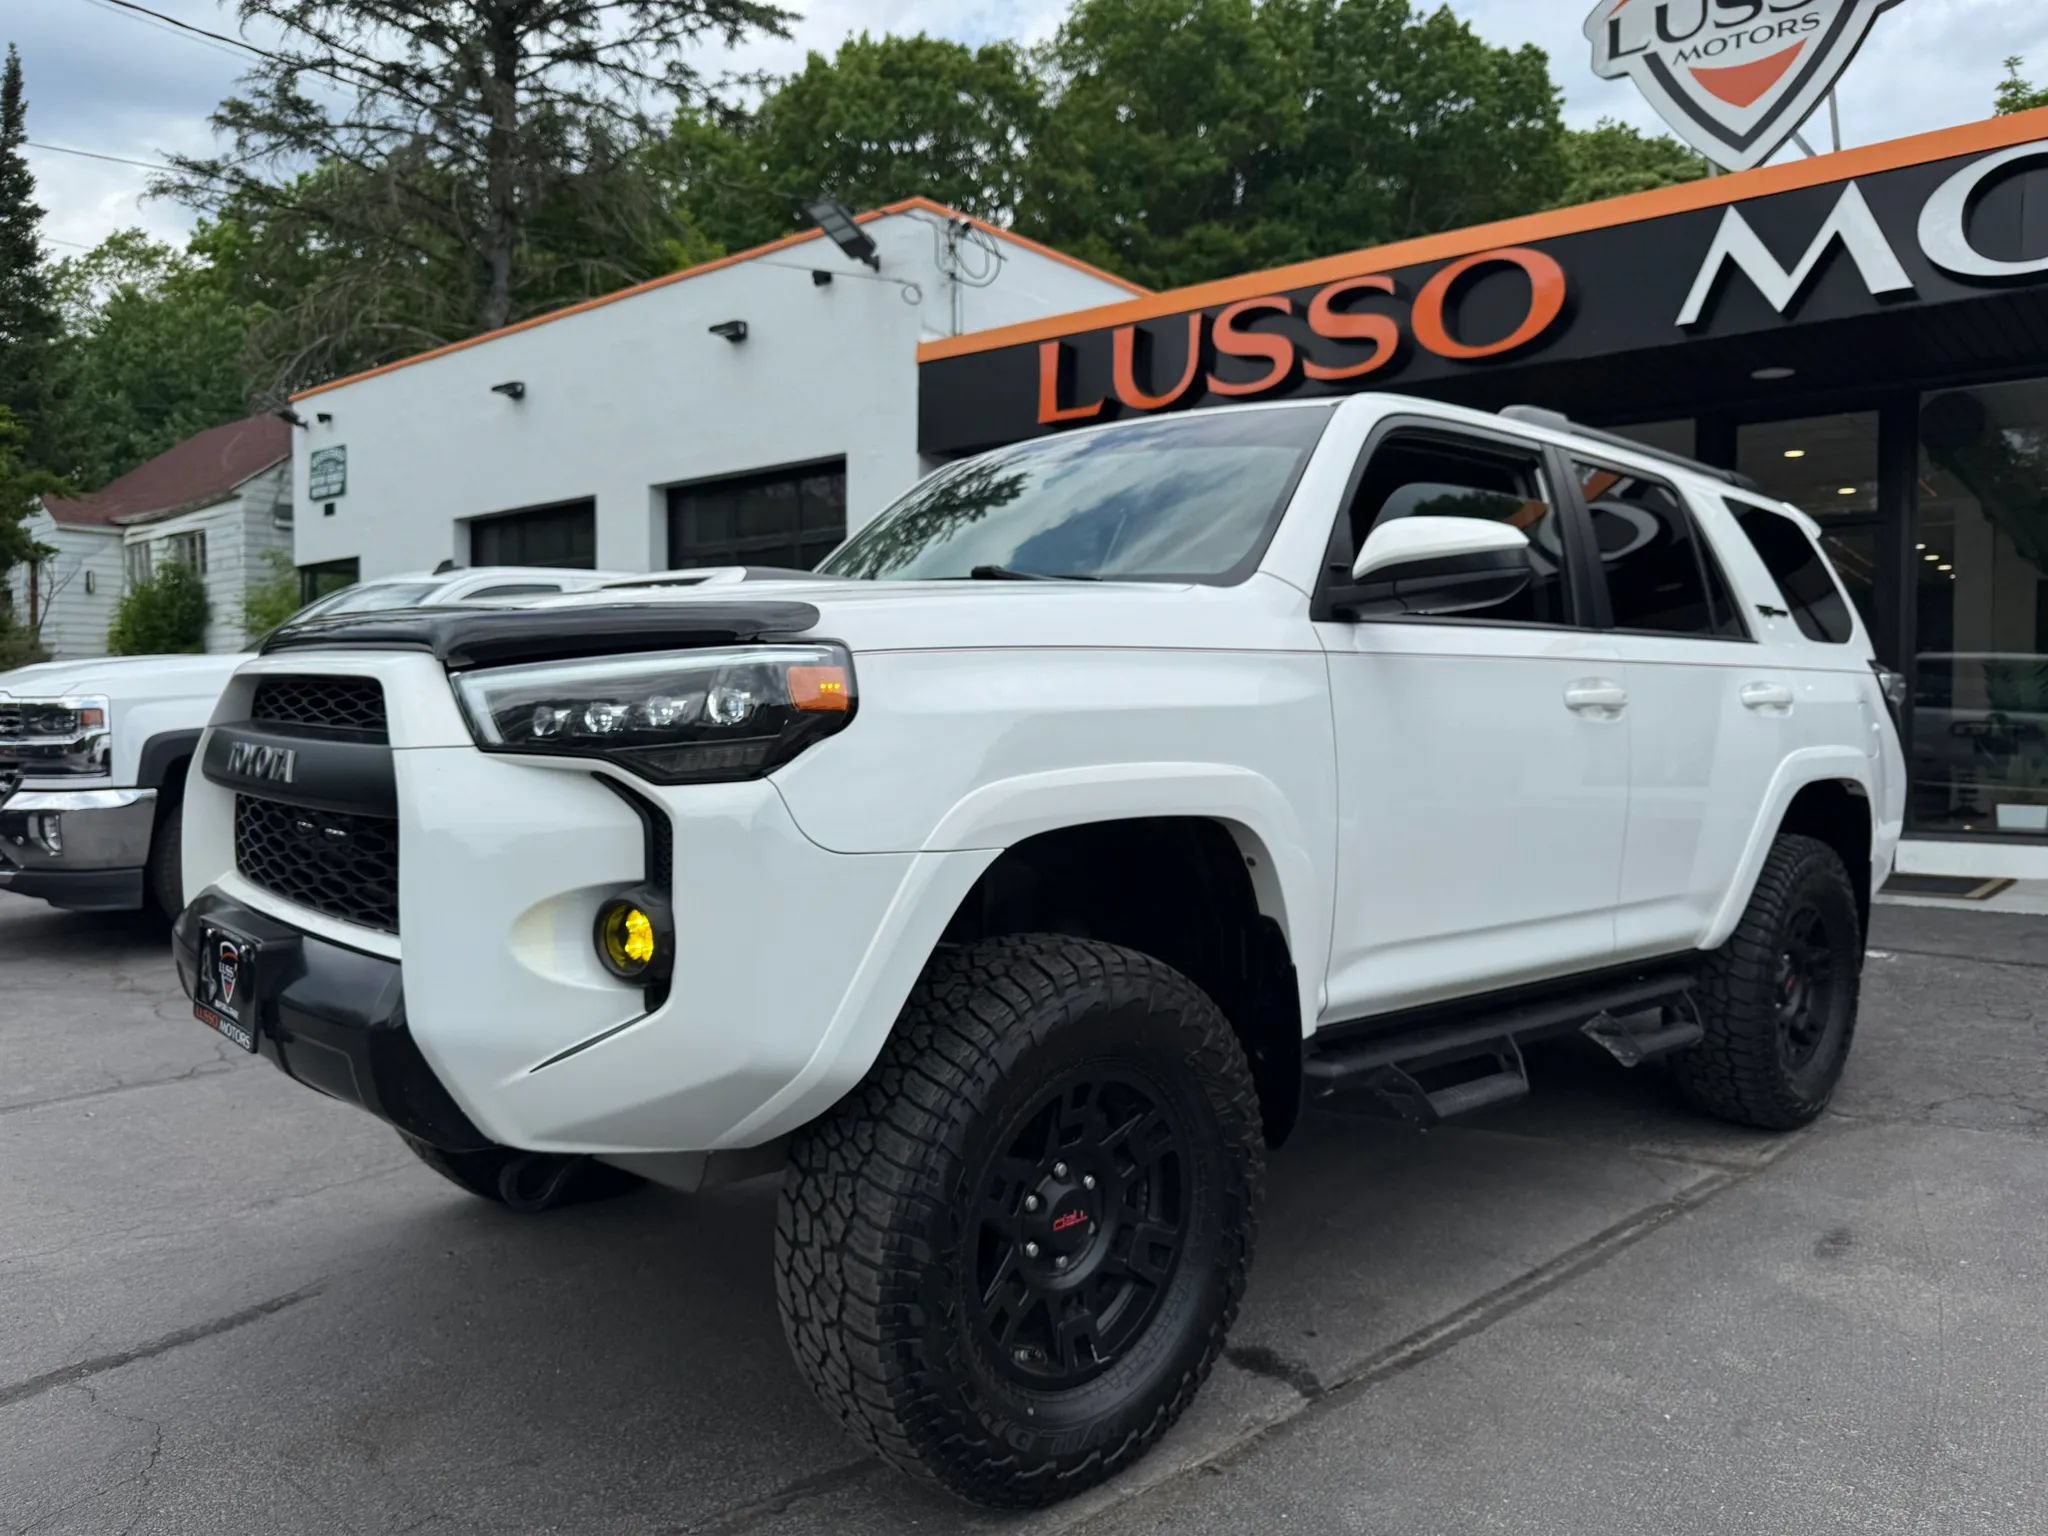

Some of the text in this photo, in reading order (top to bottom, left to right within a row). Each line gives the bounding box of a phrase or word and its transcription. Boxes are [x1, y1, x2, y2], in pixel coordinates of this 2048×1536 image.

[1672, 11, 1820, 66] MOTORS
[1037, 246, 1566, 424] LUSSO
[227, 741, 296, 784] TOYOTA
[219, 1020, 251, 1050] MOTORS
